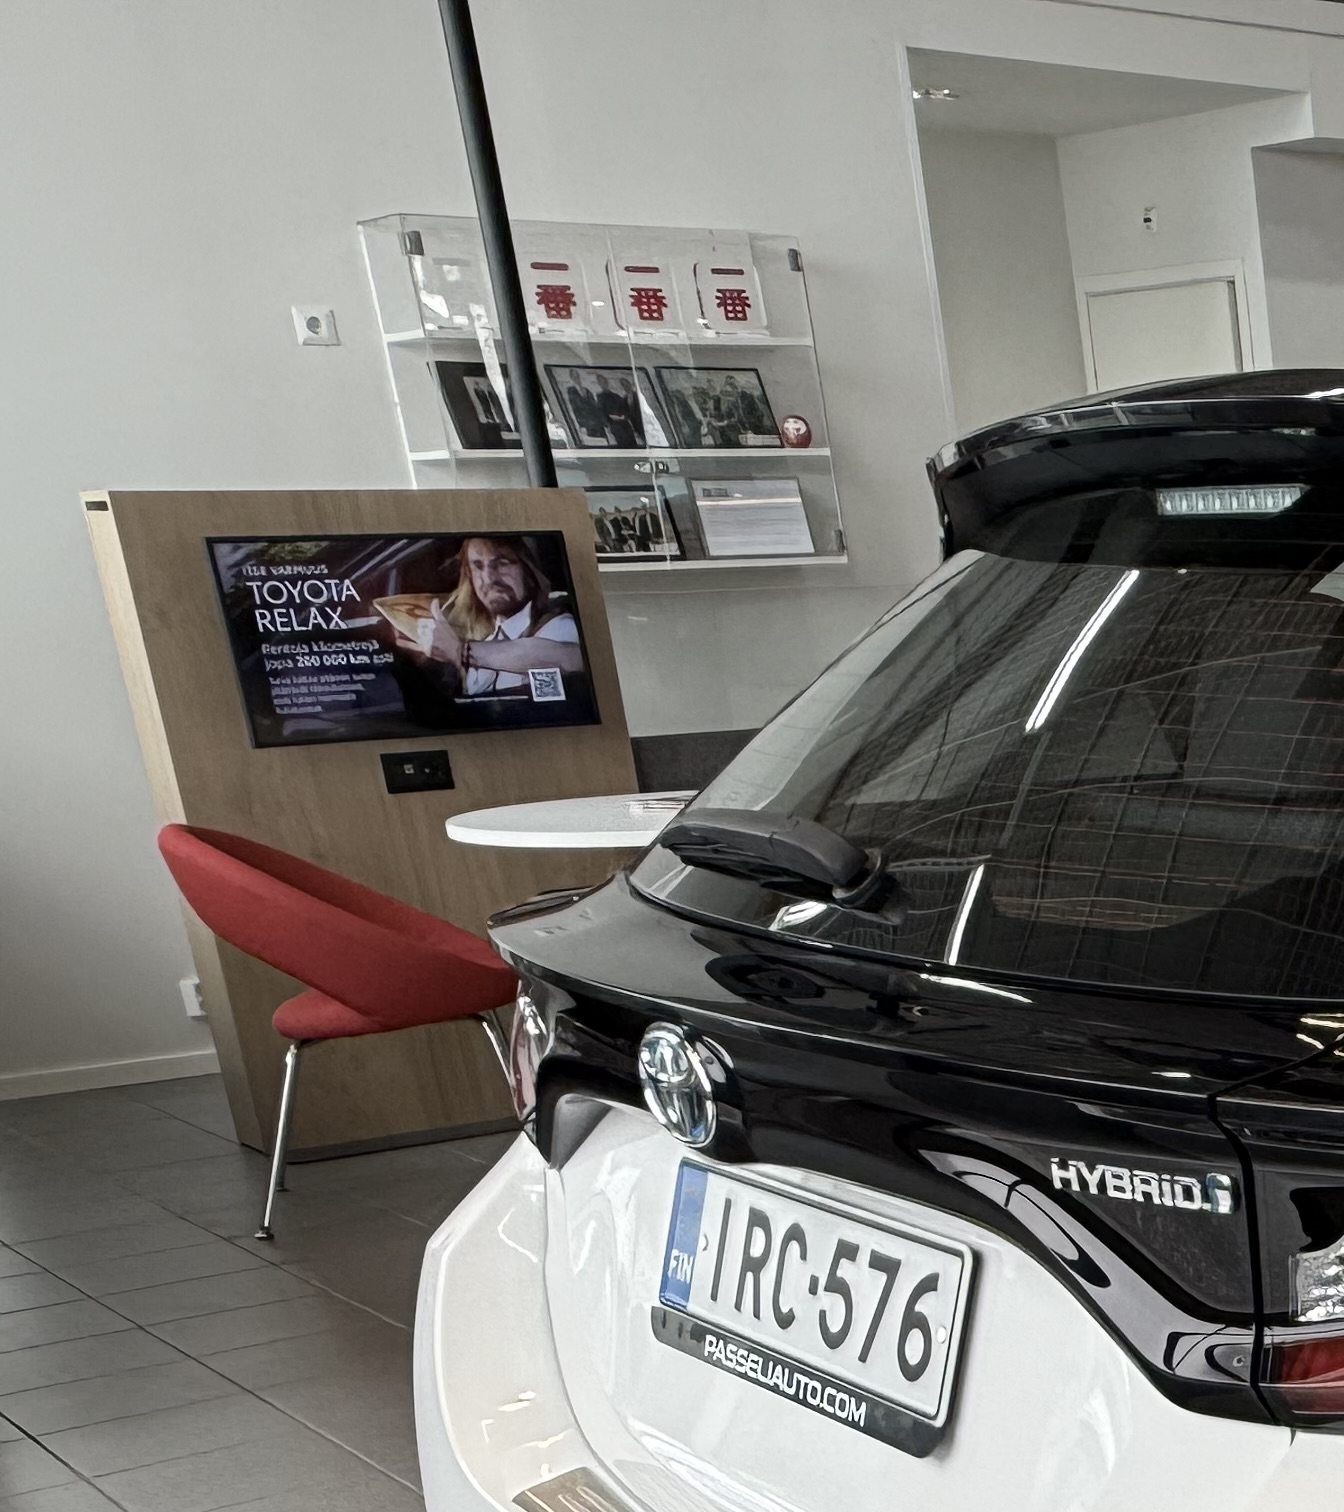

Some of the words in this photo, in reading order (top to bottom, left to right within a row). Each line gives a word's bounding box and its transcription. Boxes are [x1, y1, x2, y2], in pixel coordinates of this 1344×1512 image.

[246, 579, 361, 605] TOYOTA
[255, 606, 348, 632] RELAX
[667, 1248, 695, 1285] FIN
[709, 1197, 940, 1384] IRC-576
[703, 1334, 867, 1427] PASSELIAUTO.COM
